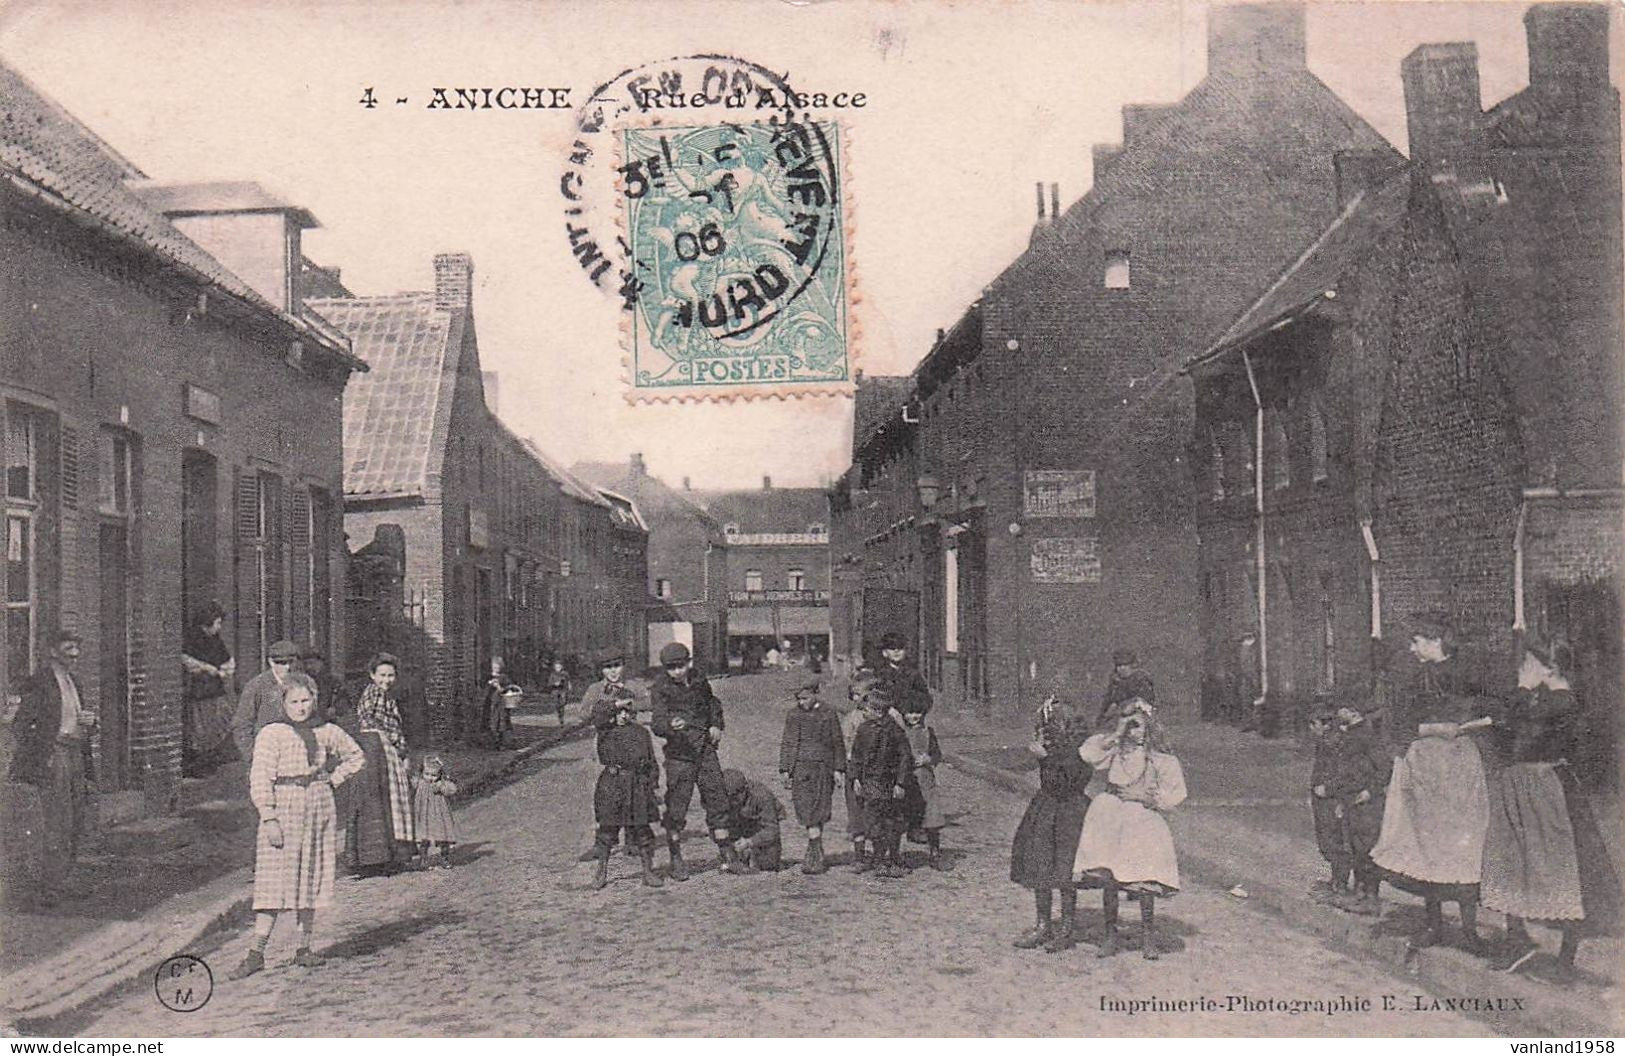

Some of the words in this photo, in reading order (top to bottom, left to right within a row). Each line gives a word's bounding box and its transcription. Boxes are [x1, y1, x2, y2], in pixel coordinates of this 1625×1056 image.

[359, 87, 378, 108] 4
[427, 87, 573, 110] ANICHE
[640, 86, 705, 109] Rue
[674, 223, 727, 262] 06
[695, 356, 787, 382] POSTES
[1381, 995, 1404, 1013] E.
